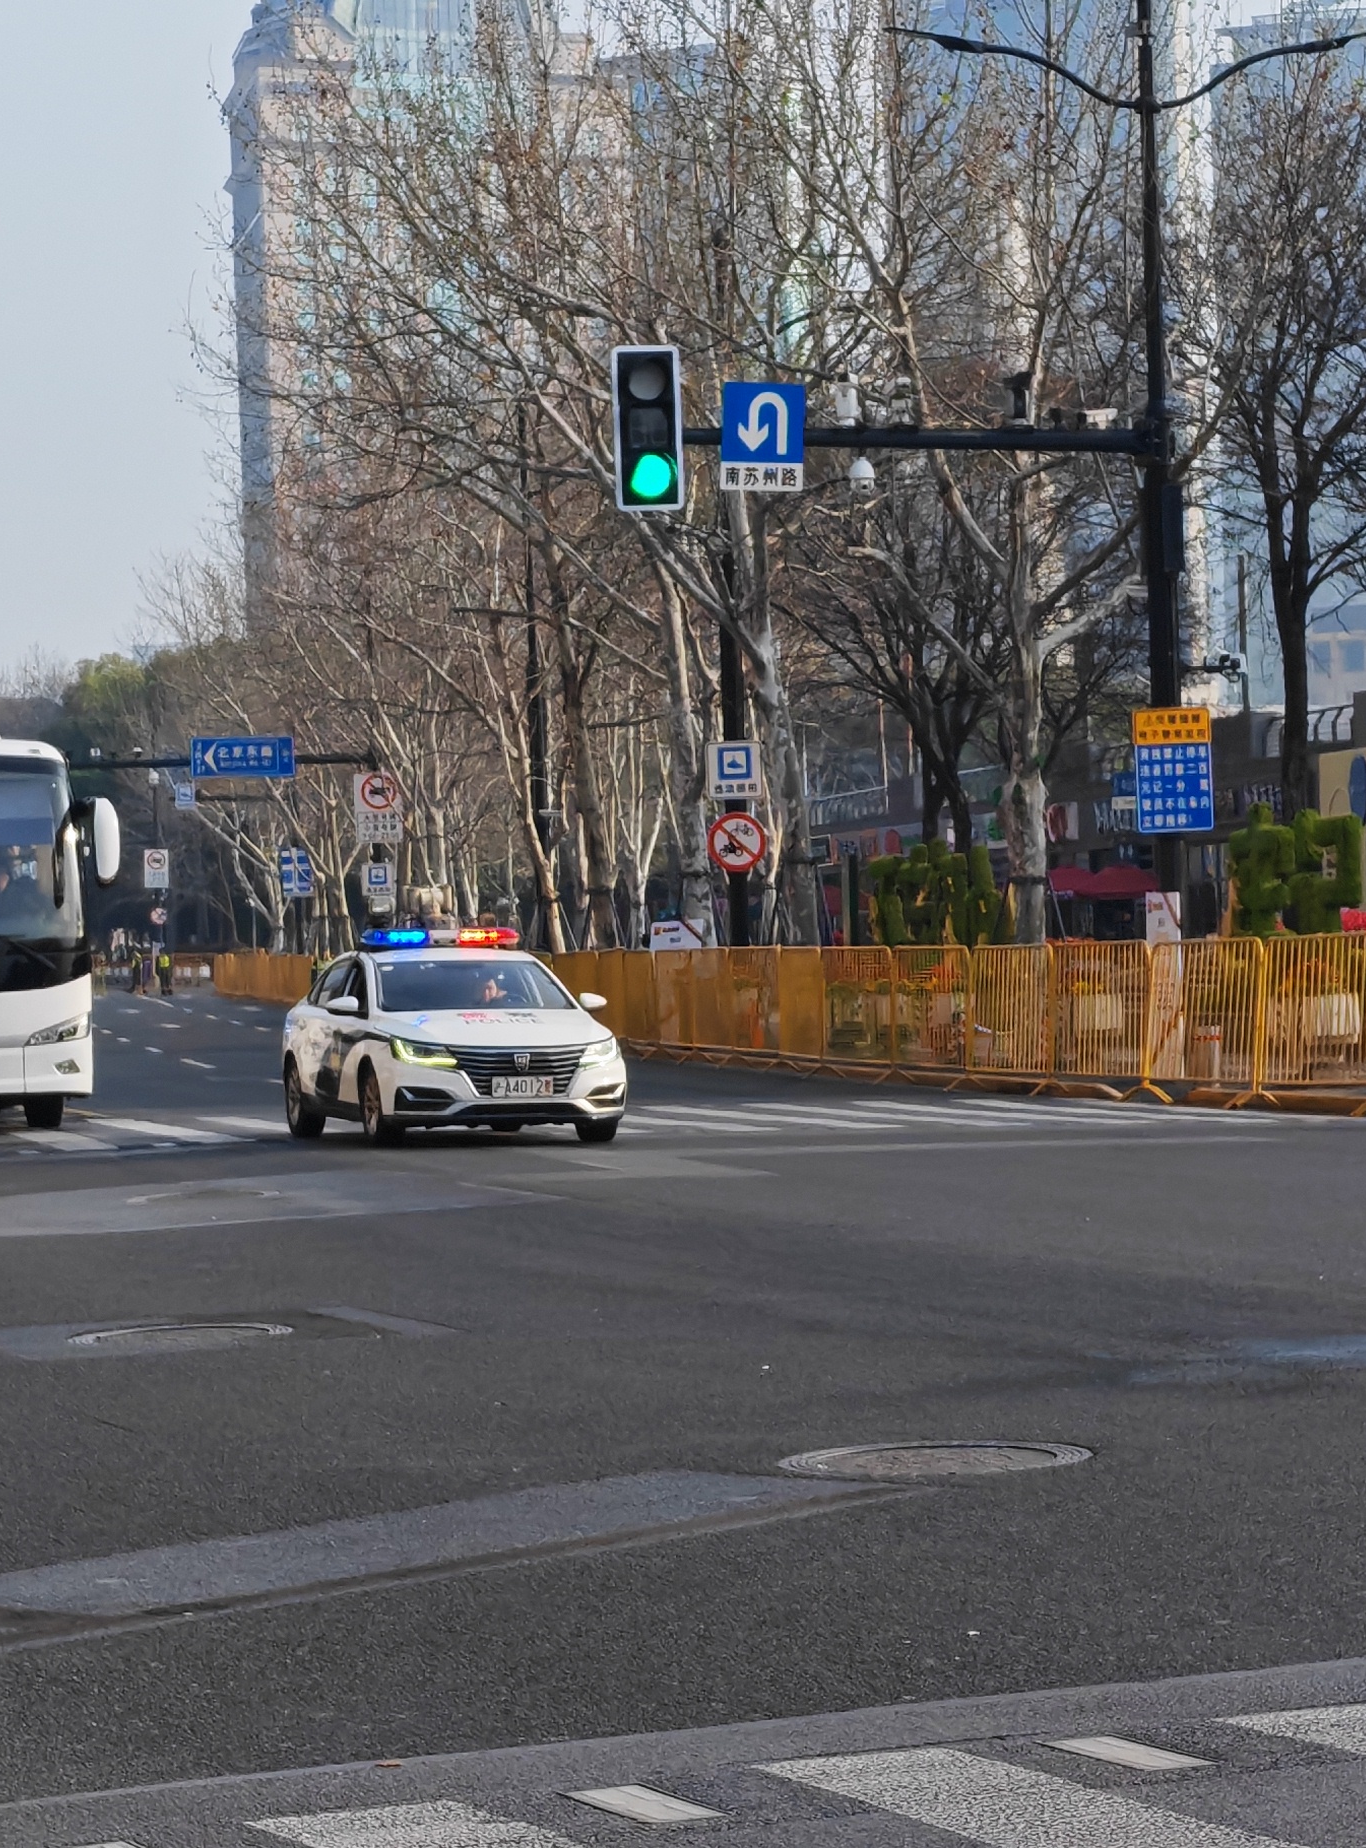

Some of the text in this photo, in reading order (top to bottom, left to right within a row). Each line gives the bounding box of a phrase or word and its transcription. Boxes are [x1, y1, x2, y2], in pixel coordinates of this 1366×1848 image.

[725, 467, 797, 486] 南苏州路
[217, 745, 273, 759] 北京东路
